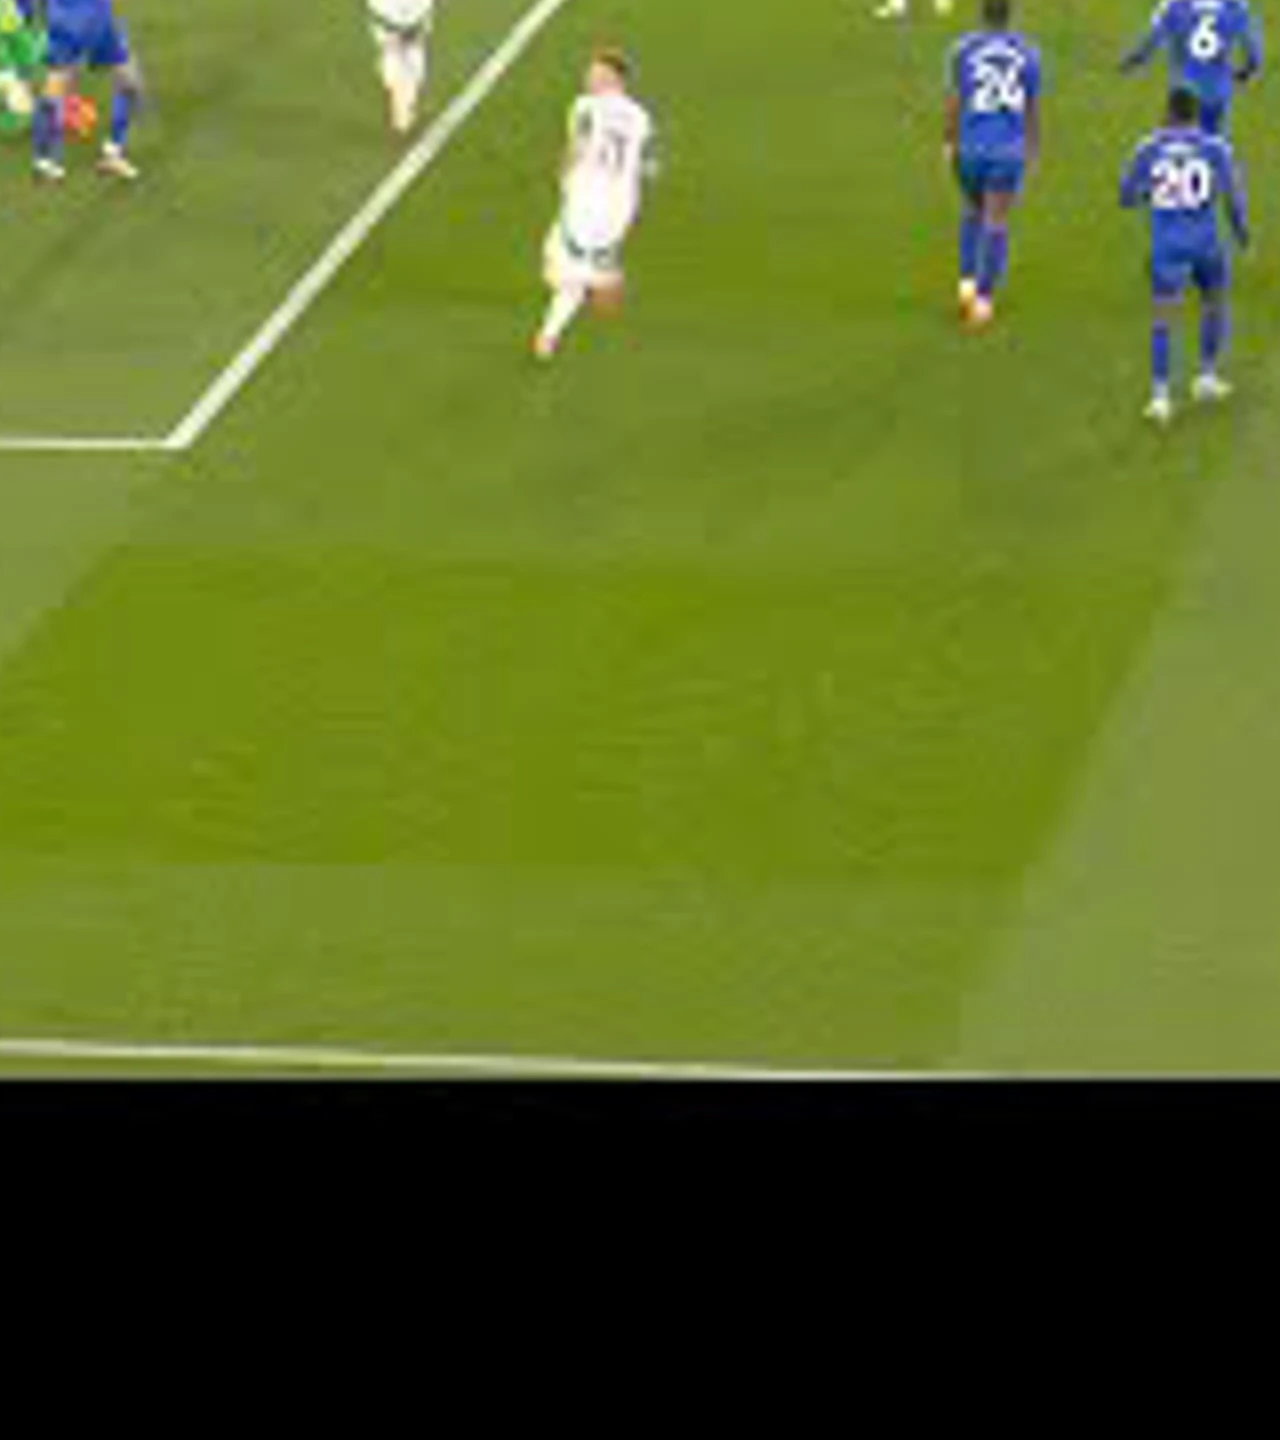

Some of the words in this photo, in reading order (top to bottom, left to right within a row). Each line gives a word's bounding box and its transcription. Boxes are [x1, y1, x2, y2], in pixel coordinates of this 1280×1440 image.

[1189, 16, 1219, 60] 6
[972, 62, 1026, 113] 24
[1150, 159, 1211, 209] 20
